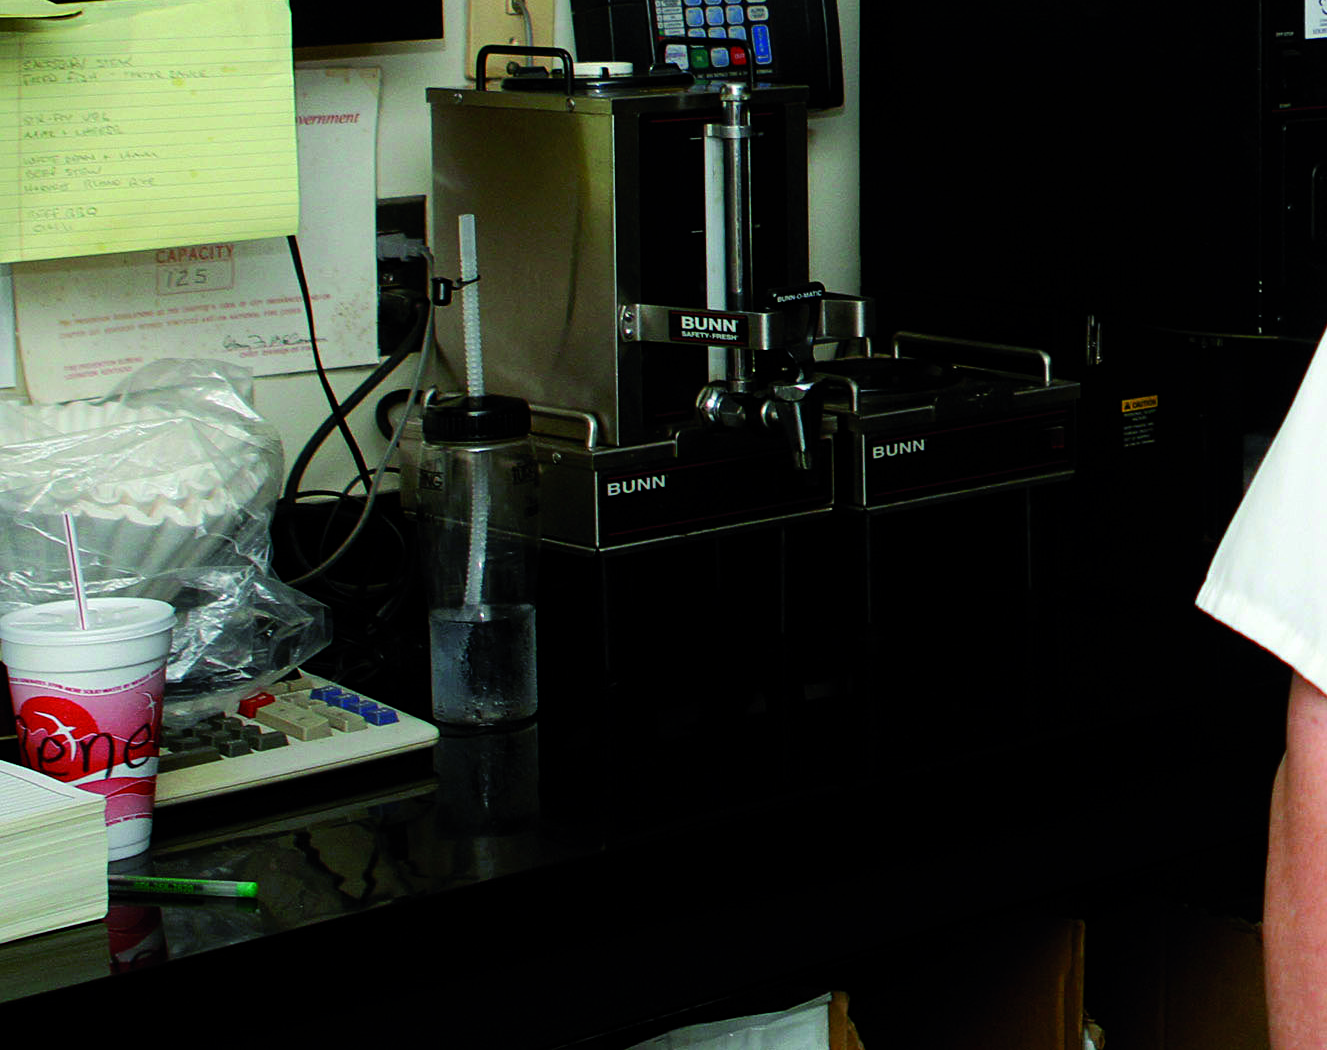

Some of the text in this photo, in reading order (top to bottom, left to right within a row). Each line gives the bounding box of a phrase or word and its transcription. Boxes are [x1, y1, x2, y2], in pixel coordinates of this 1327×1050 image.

[296, 113, 360, 125] vernment
[155, 244, 234, 264] CAPACITY
[167, 268, 208, 288] 125
[776, 289, 823, 303] BUNN-O-MATIC
[681, 316, 739, 333] BUNN
[681, 331, 739, 341] SAFETY-FRESH
[872, 439, 926, 459] BUNN
[607, 474, 666, 496] BUNN
